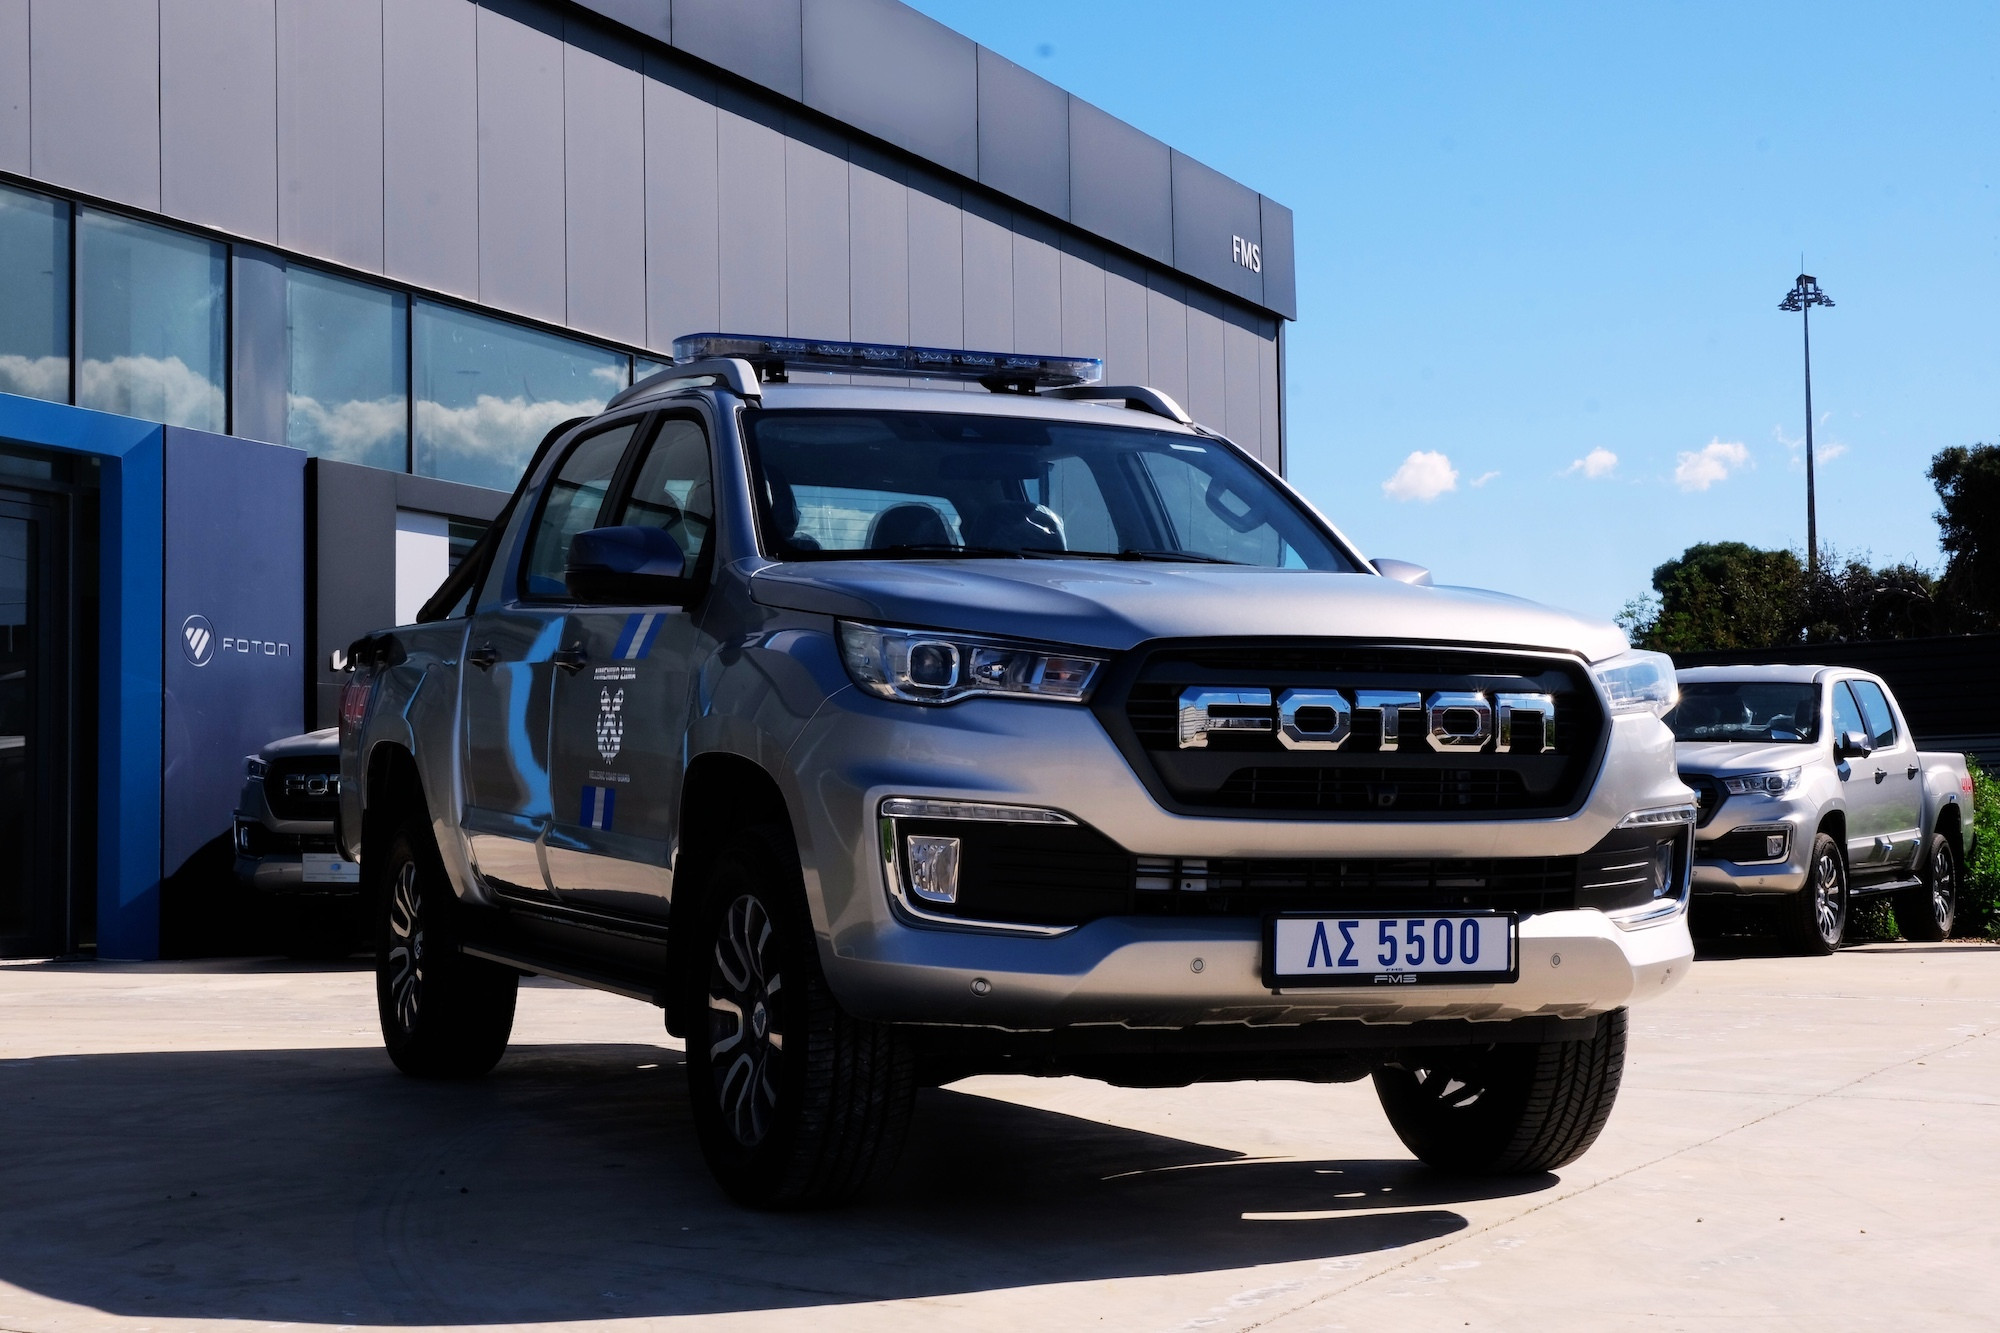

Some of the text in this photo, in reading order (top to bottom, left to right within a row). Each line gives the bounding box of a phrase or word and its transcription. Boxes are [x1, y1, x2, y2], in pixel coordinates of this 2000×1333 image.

[1232, 234, 1261, 273] FMS
[223, 637, 290, 657] FOTON
[1178, 686, 1556, 753] FOTON
[1307, 918, 1480, 968] ΛΣ 5500
[1373, 974, 1418, 984] FMS
